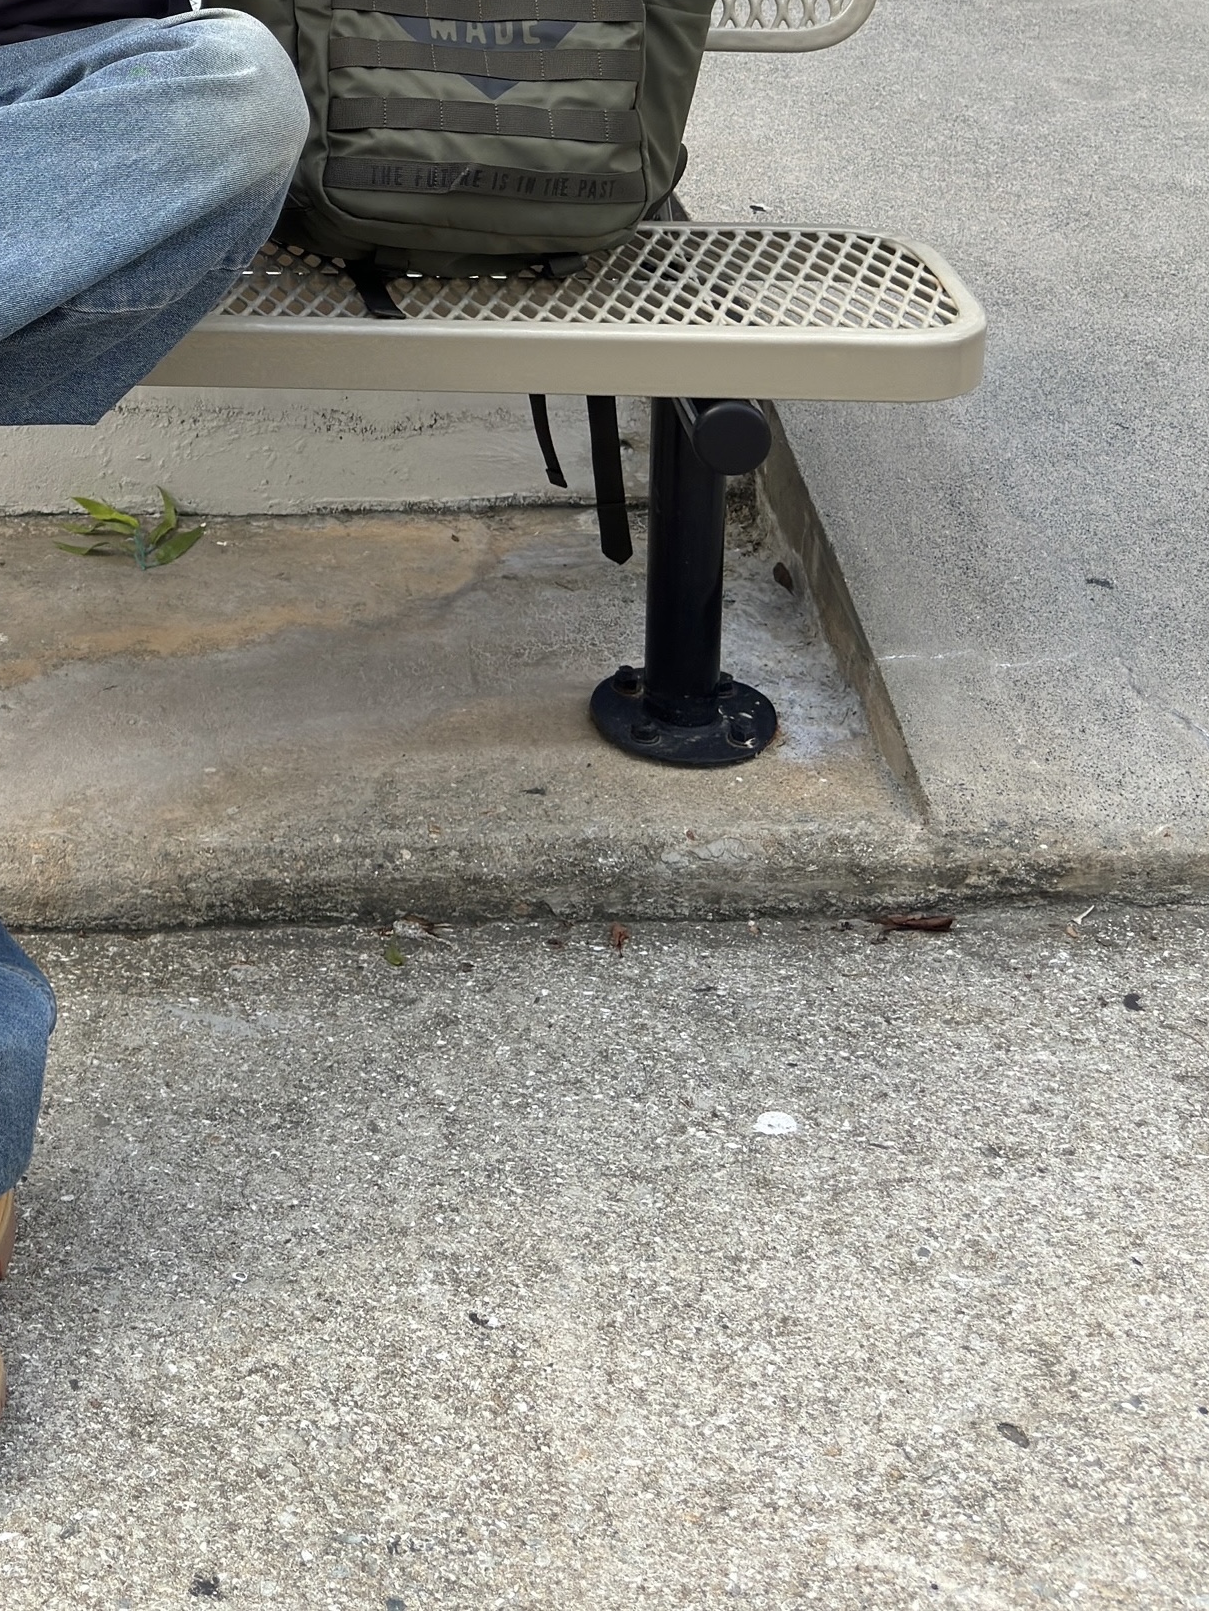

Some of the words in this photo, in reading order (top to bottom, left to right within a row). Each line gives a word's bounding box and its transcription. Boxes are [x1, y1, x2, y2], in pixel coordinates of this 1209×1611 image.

[370, 165, 402, 186] THE
[415, 166, 482, 189] FUTRE
[492, 172, 509, 191] IS
[544, 176, 570, 197] THE
[578, 179, 617, 200] PAST
